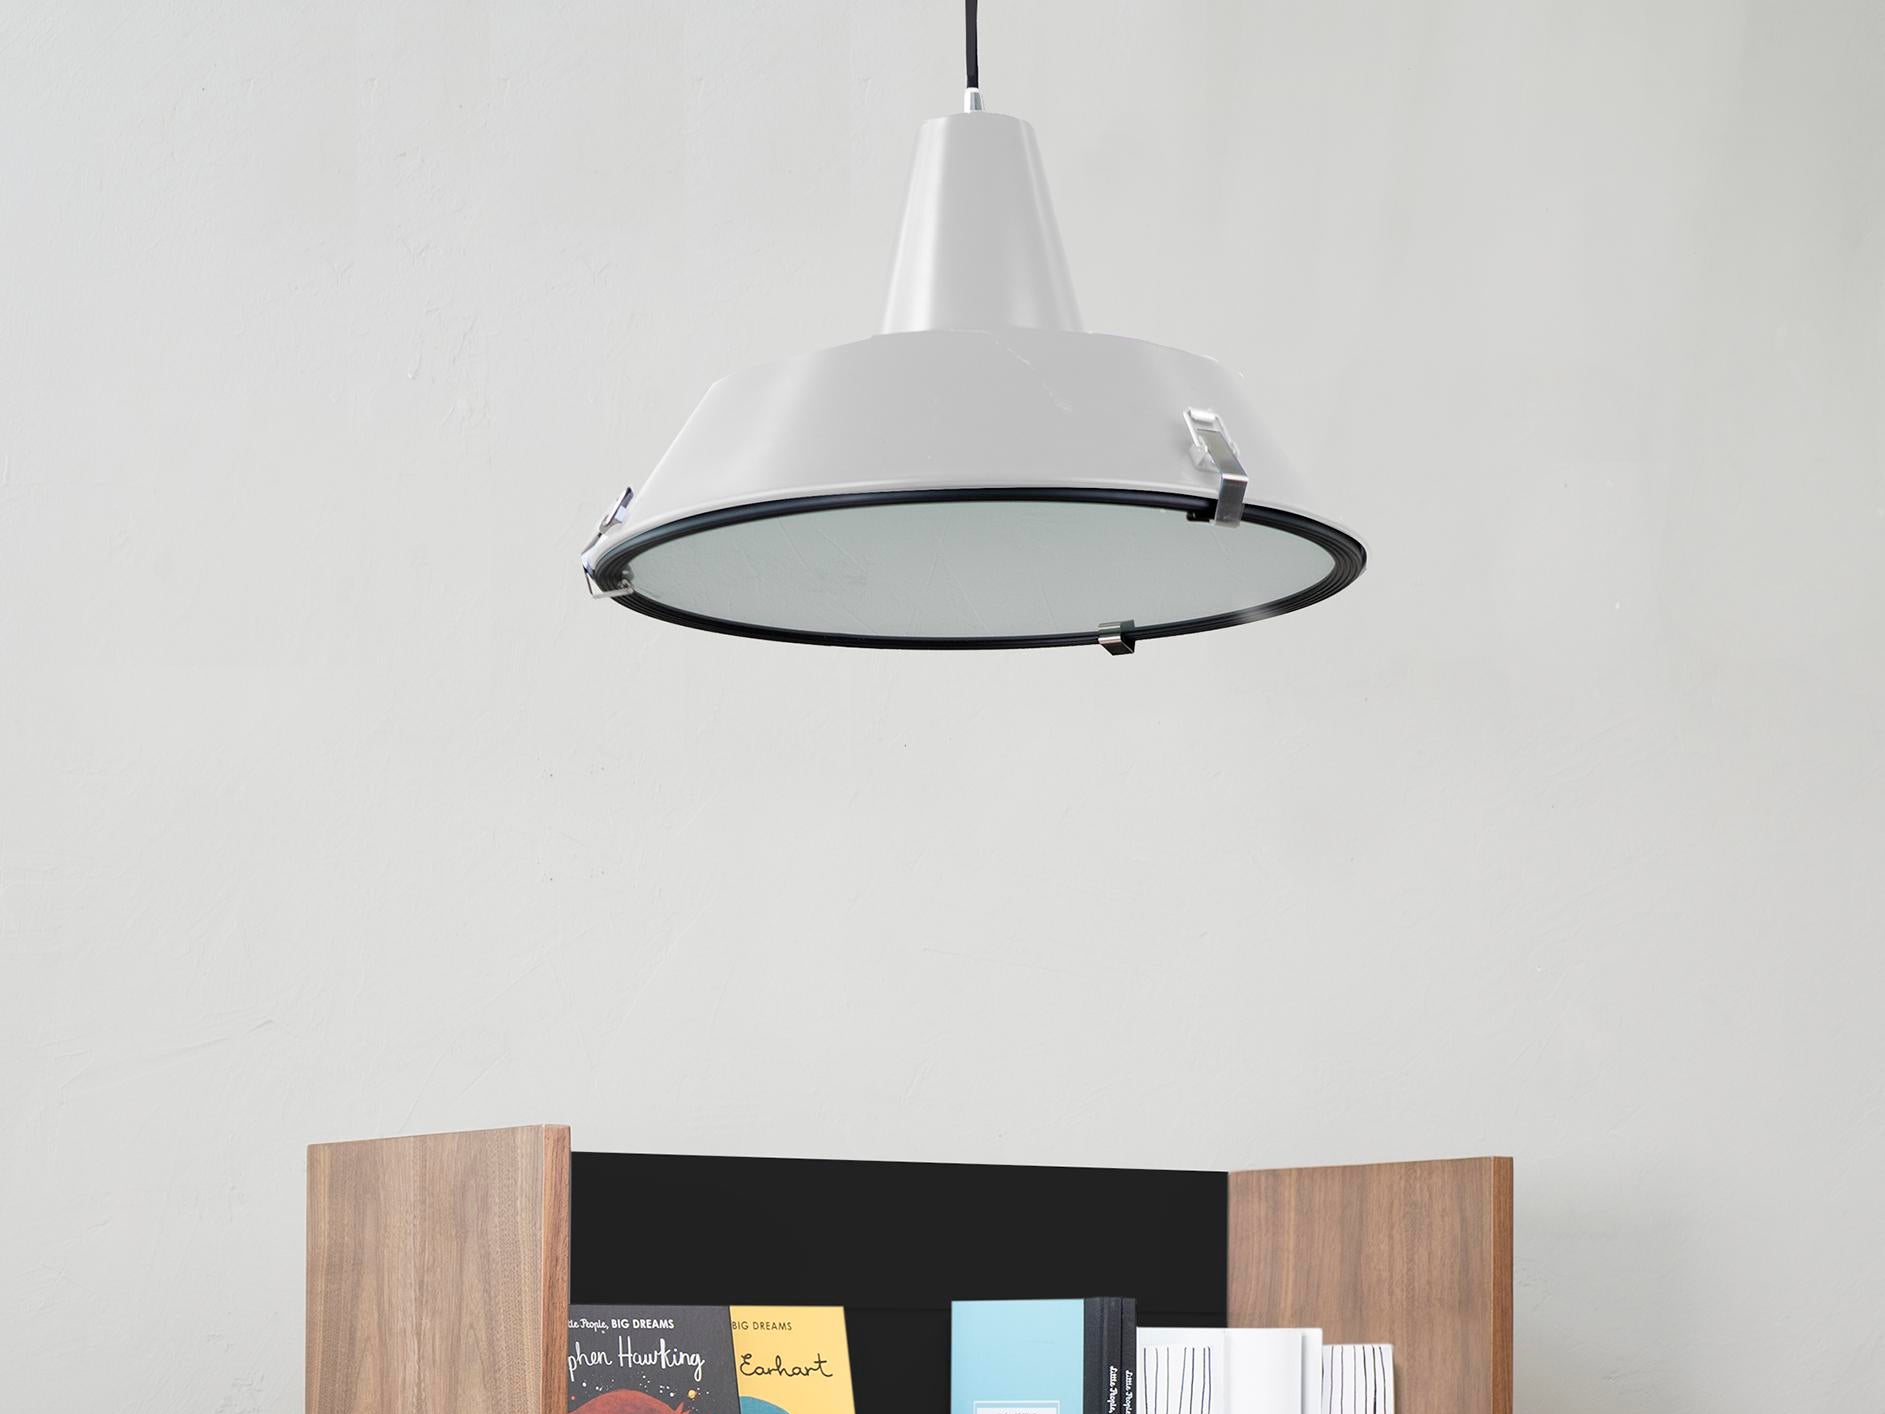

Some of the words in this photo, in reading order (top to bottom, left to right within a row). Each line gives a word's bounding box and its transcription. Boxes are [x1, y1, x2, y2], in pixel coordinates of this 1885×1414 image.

[611, 1319, 630, 1329] BIG
[632, 1319, 675, 1330] DREAMS
[732, 1321, 749, 1331] BIG
[752, 1321, 793, 1331] DREAMS
[567, 1341, 613, 1382] phen
[618, 1335, 706, 1382] Hawking
[739, 1352, 833, 1377] Earhart
